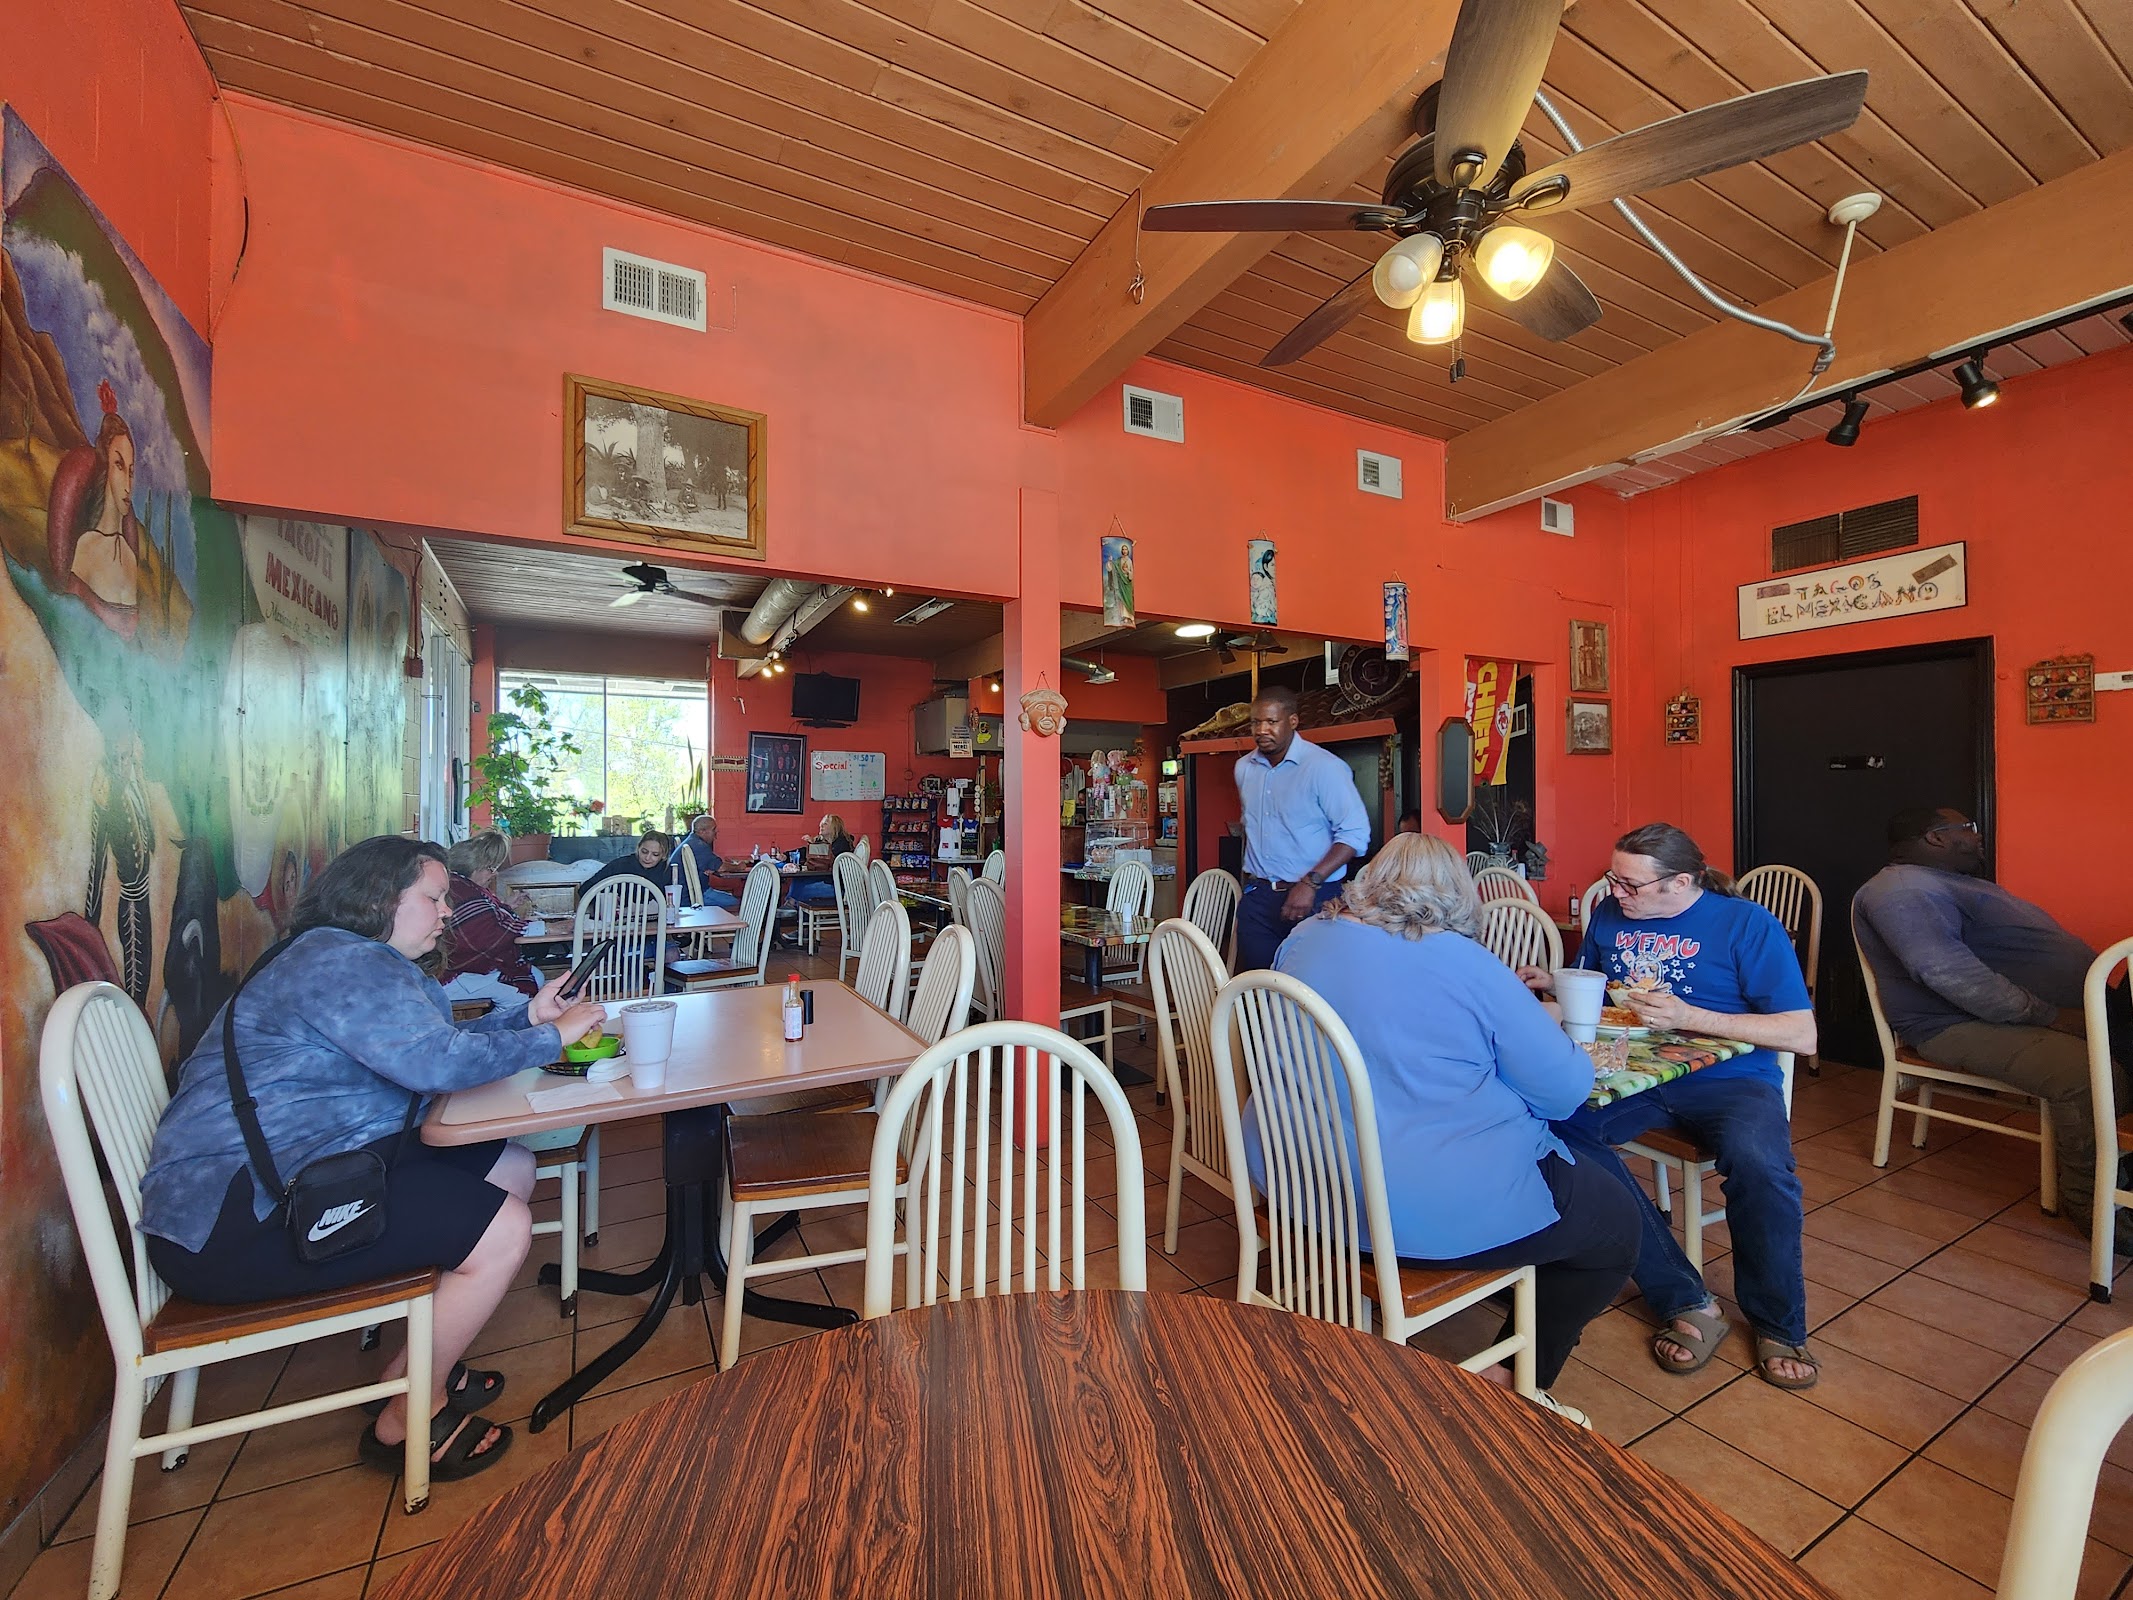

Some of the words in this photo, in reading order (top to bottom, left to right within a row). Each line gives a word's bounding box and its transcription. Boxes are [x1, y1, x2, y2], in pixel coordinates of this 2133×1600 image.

[265, 551, 339, 630] MEXICANO
[1794, 571, 1882, 600] TACOS
[1767, 604, 1793, 625] EL
[1796, 582, 1939, 619] MEXICANO
[815, 760, 848, 773] Special
[1615, 930, 1701, 959] WFMU
[318, 1199, 364, 1228] NIKE
